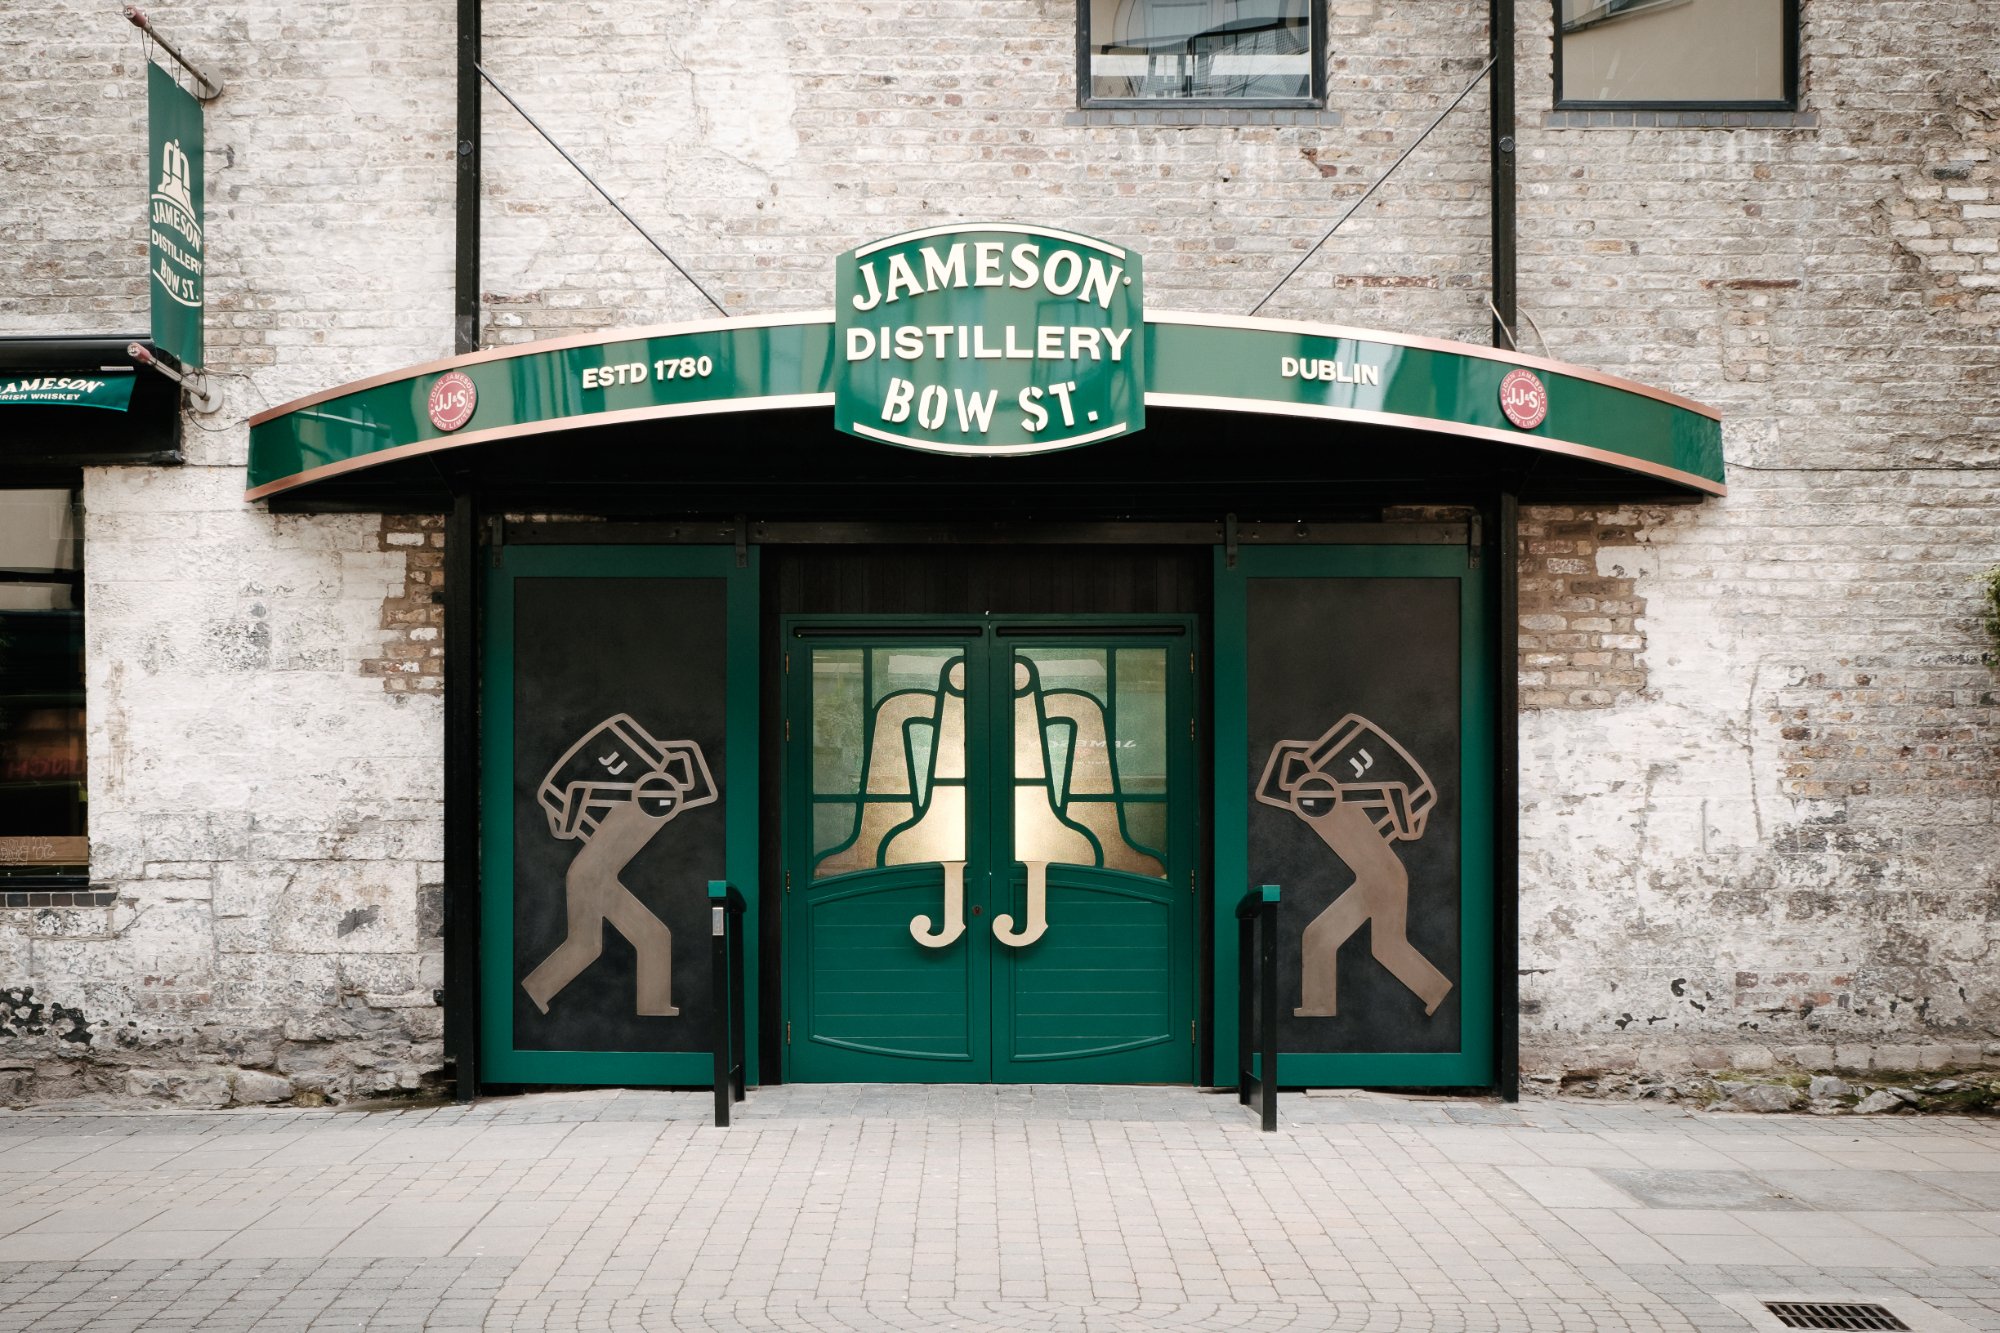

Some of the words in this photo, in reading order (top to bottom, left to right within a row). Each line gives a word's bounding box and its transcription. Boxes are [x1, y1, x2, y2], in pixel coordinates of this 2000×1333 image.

[153, 202, 201, 253] JAMESON
[151, 229, 203, 276] DISTILLERY
[161, 258, 180, 294] BOW
[182, 279, 200, 300] ST.
[852, 242, 1124, 311] JAMESON
[847, 325, 1132, 361] DISTILLERY
[0, 377, 102, 394] AMESON
[582, 362, 648, 389] ESTD
[654, 356, 713, 381] 1780
[1281, 357, 1379, 385] DUBLIN
[881, 378, 998, 433] BOW
[1018, 381, 1099, 432] ST.
